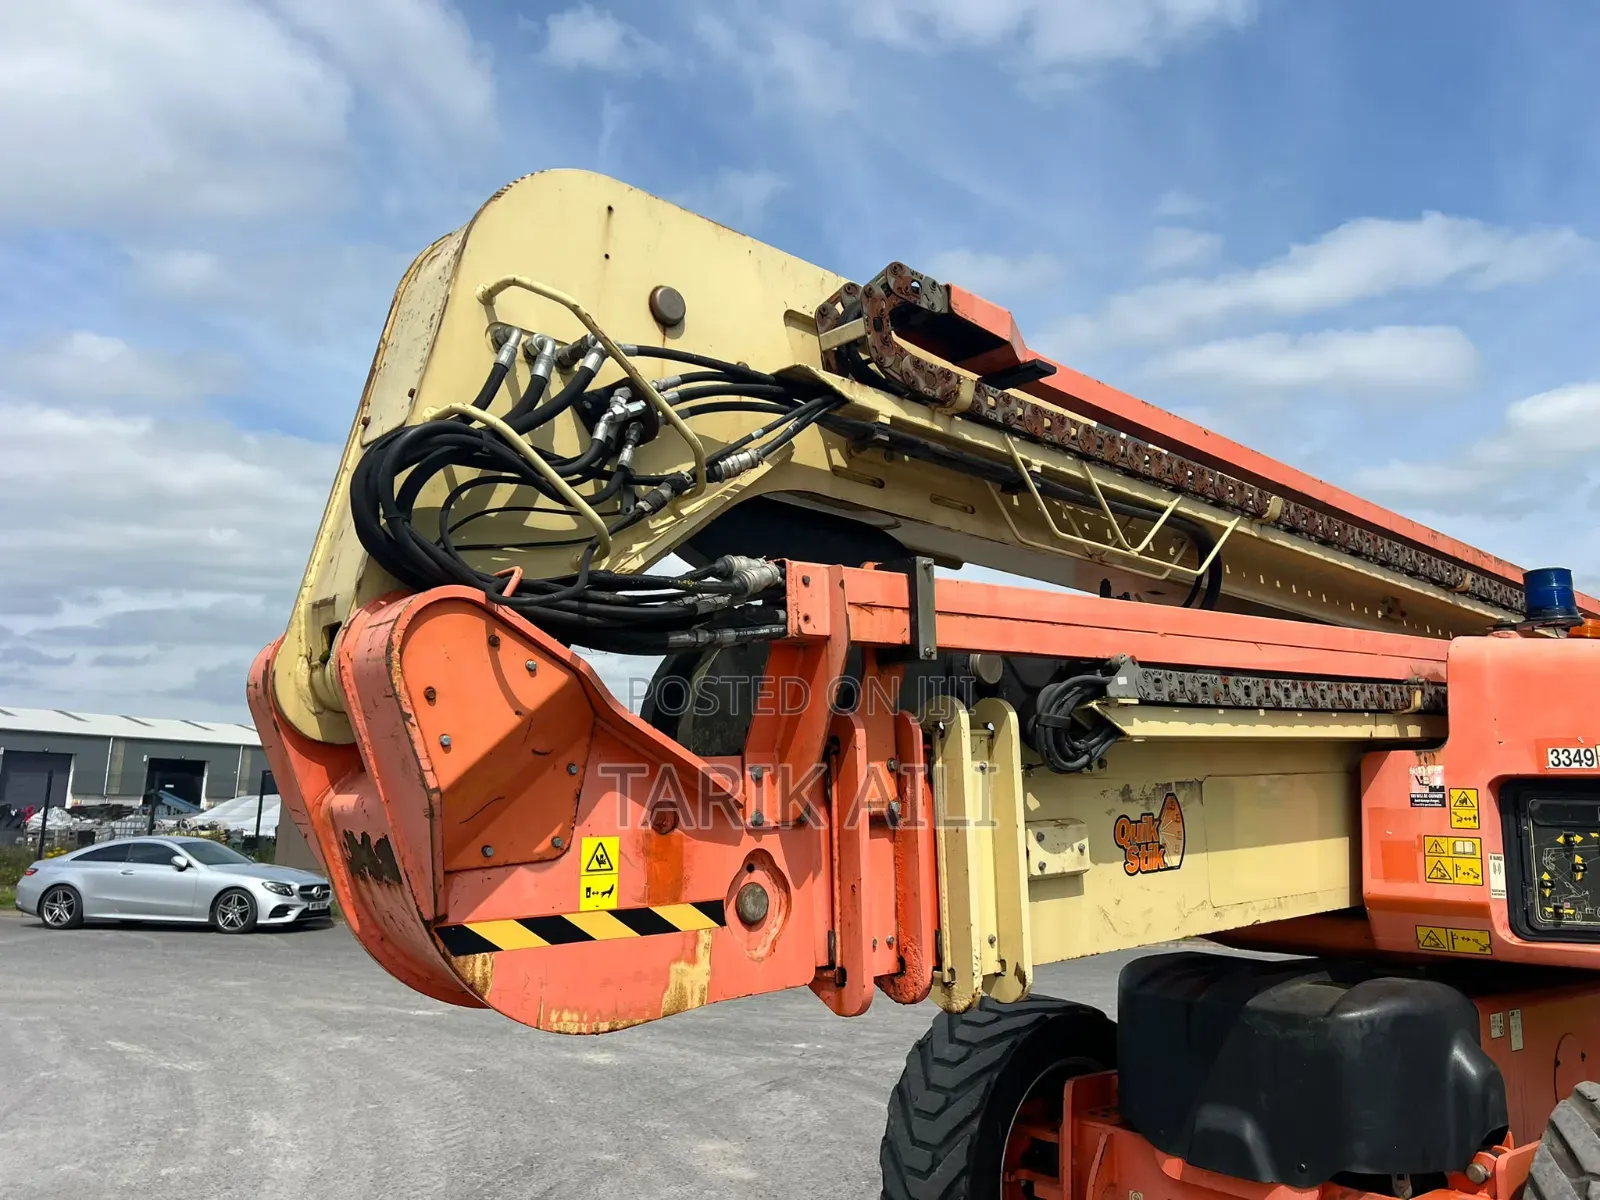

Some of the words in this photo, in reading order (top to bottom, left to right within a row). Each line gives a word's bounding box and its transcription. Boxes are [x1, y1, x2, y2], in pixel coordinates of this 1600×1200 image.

[1550, 748, 1595, 767] 3349
[1114, 815, 1160, 849] Quik
[1125, 843, 1166, 874] Stik
